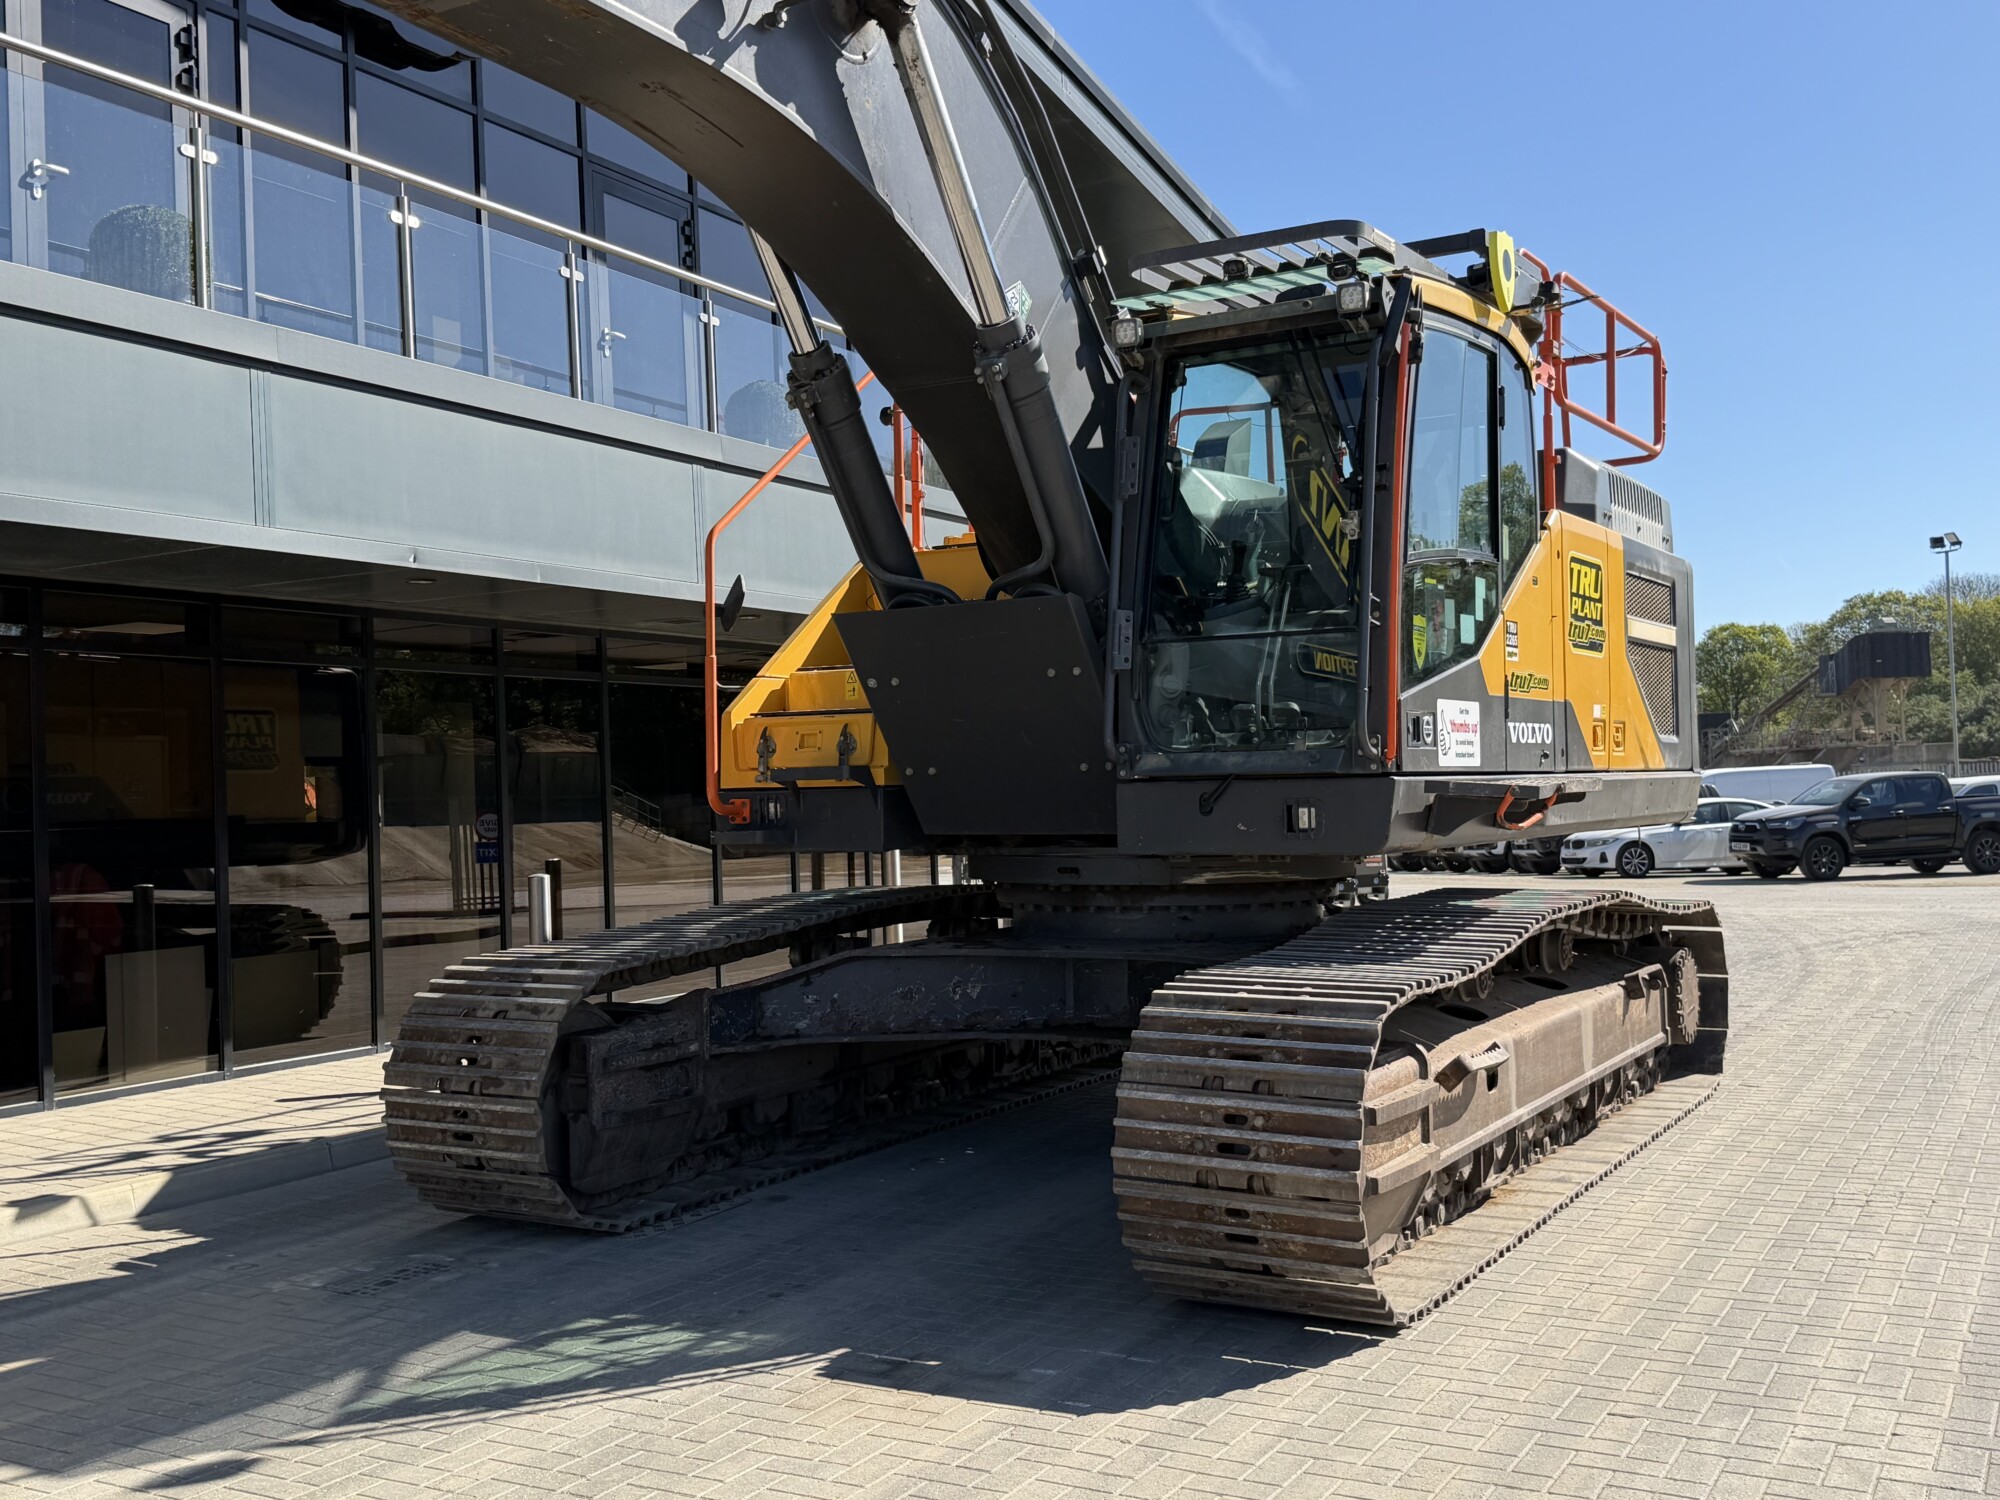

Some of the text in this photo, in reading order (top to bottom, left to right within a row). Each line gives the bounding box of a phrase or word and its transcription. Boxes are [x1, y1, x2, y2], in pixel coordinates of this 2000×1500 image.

[1570, 562, 1602, 600] TRU
[1571, 596, 1602, 620] PLANT
[1568, 621, 1606, 642] tru7.com
[1509, 671, 1550, 693] tru7.com
[1507, 722, 1552, 744] VOLVO
